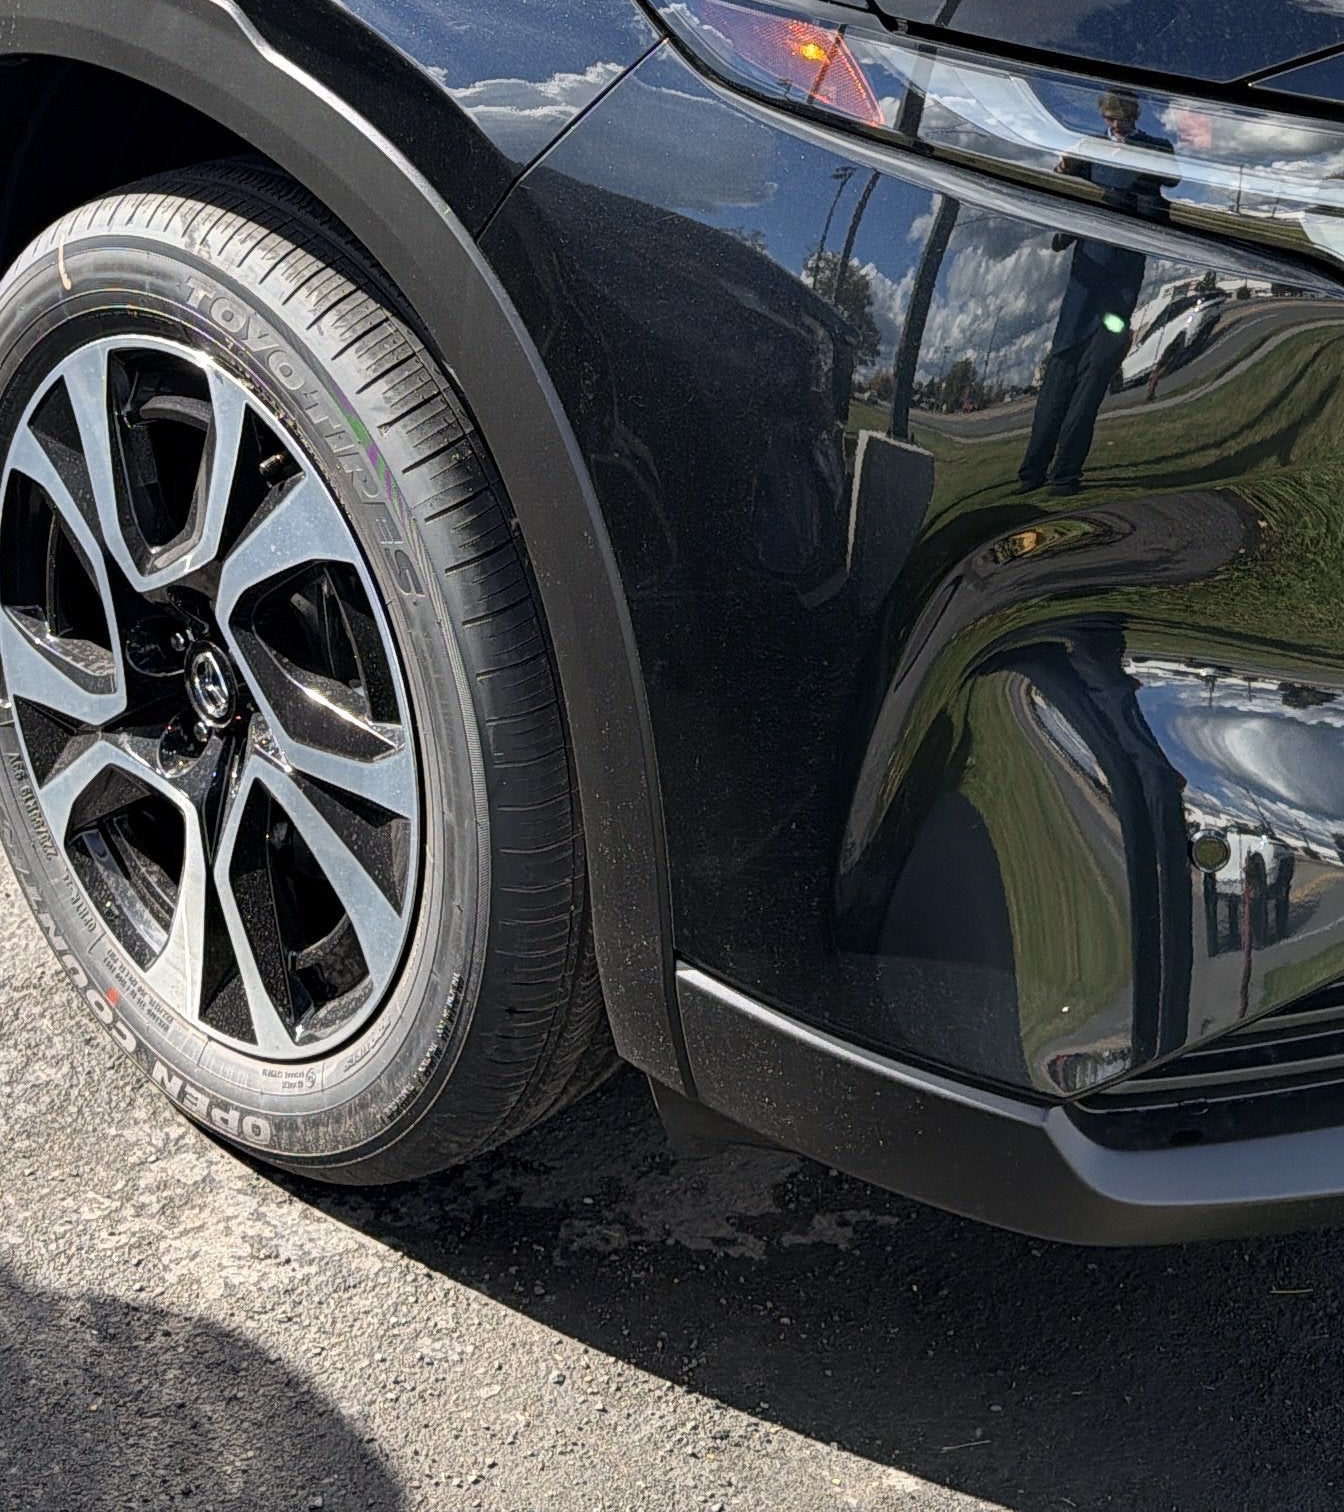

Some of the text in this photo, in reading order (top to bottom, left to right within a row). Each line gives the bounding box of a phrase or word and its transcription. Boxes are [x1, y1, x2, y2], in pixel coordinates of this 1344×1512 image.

[185, 275, 425, 597] TOYO TIRES
[151, 1060, 272, 1145] OPEN
